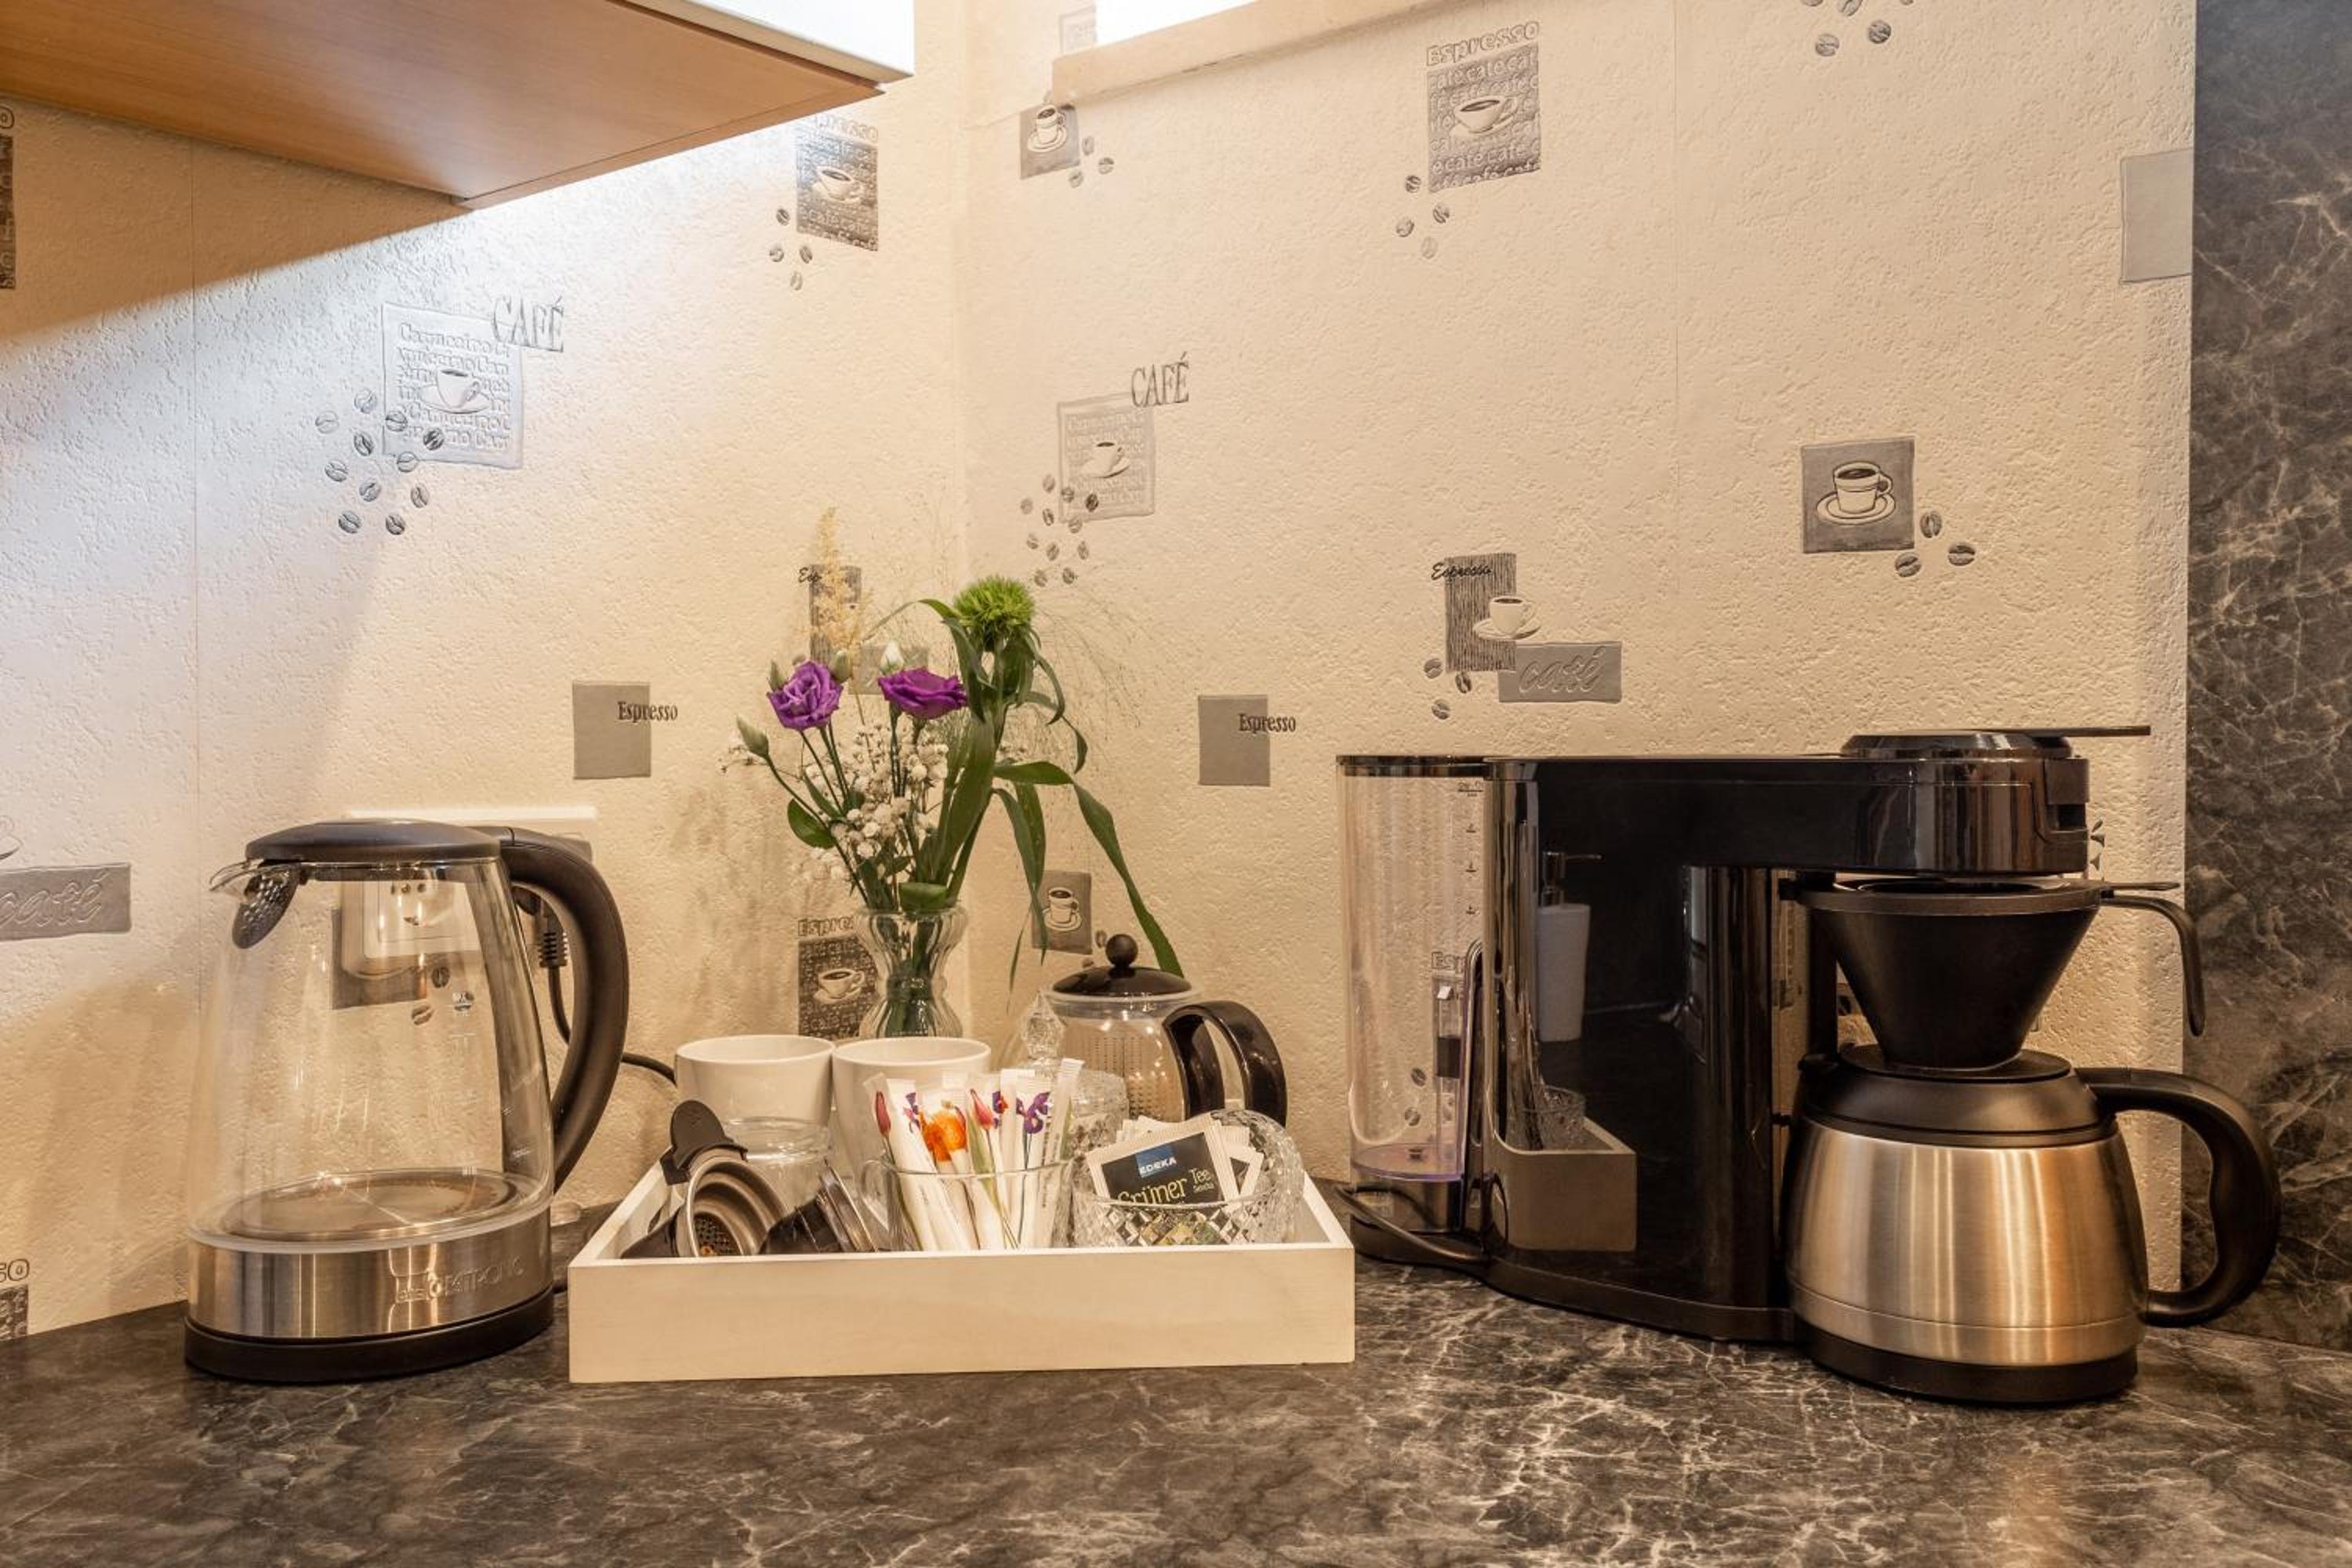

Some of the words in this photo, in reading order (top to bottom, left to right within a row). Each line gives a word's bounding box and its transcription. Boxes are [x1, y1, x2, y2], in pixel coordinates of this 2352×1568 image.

[1426, 20, 1540, 67] Espresso
[492, 295, 564, 353] CAFÉ
[1131, 350, 1190, 408] CAFÉ
[1431, 561, 1492, 581] Espresso
[617, 700, 679, 724] Espresso
[1238, 713, 1297, 735] Espresso
[798, 915, 854, 937] Espre
[1432, 951, 1466, 975] Esp
[1138, 1156, 1178, 1174] EDEKA
[1188, 1167, 1213, 1185] Tee
